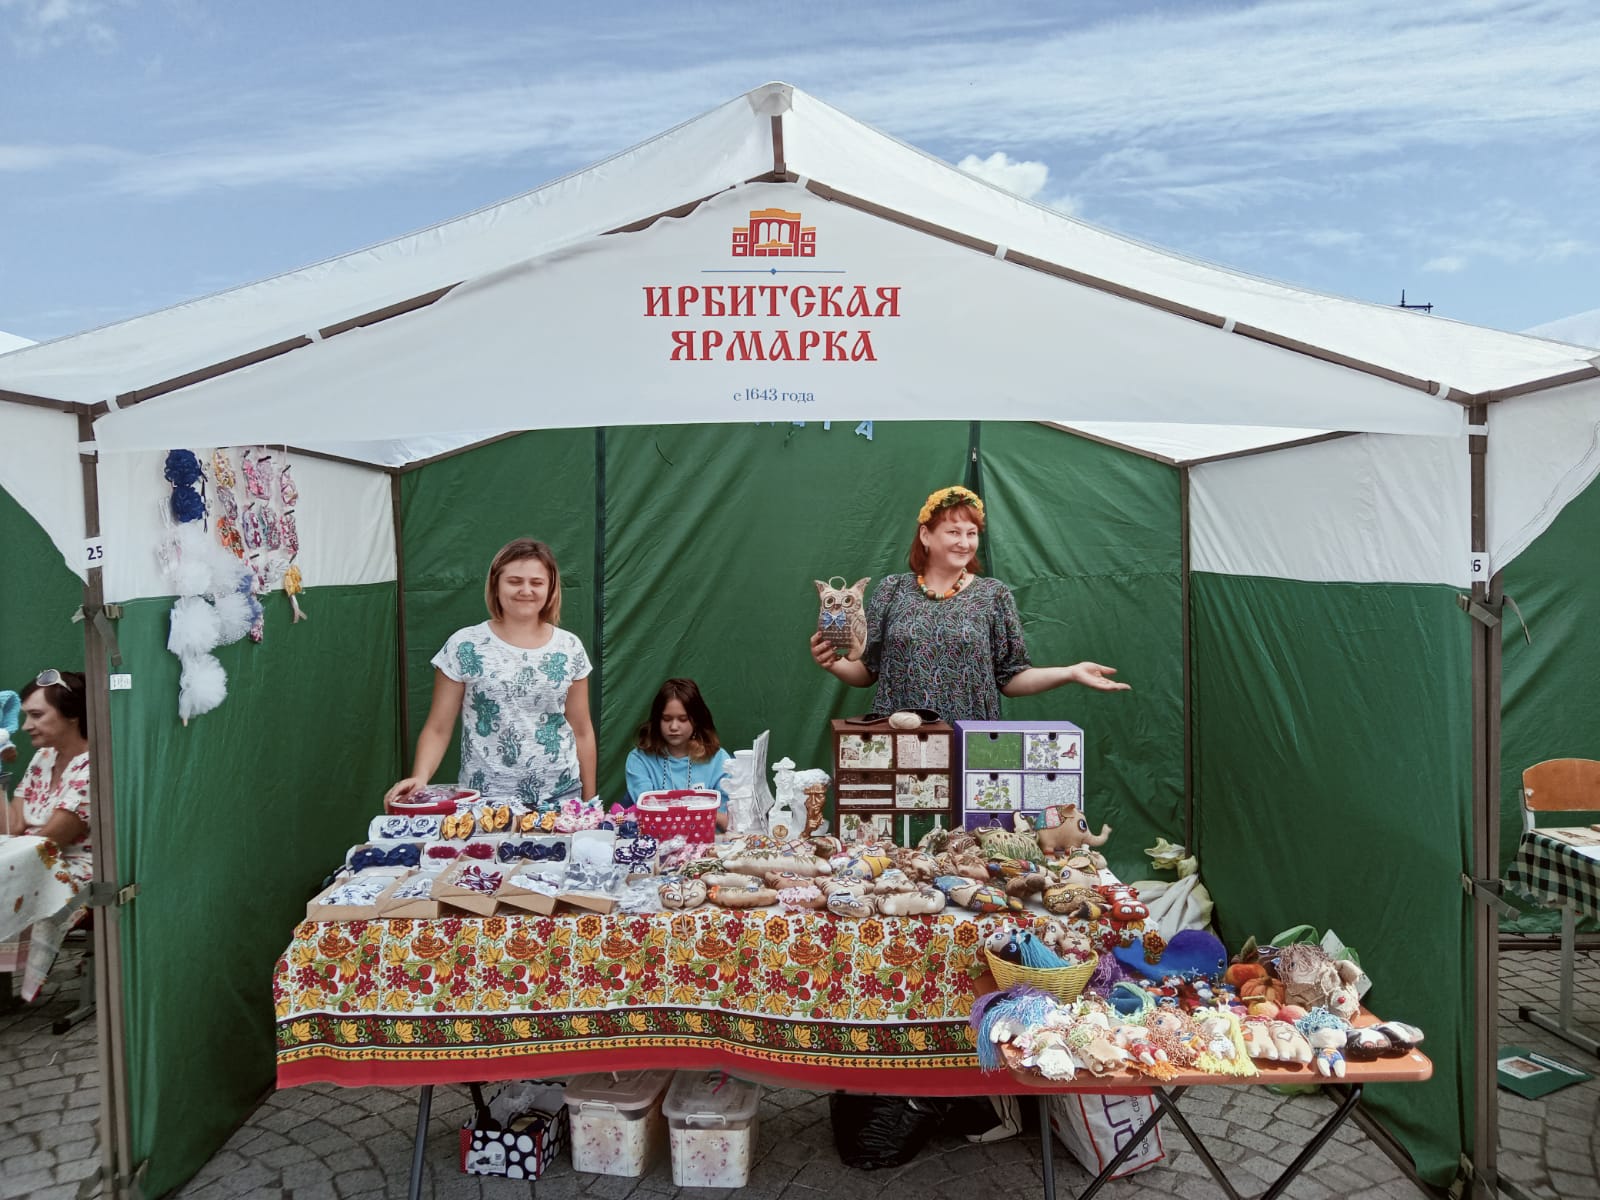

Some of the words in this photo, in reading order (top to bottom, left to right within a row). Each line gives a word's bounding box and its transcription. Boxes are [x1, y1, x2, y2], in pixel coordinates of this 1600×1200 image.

[642, 285, 902, 318] ИРБИТСКАЯ
[669, 330, 878, 362] ЯРМАРКА
[733, 392, 742, 402] с
[745, 388, 778, 401] 1643
[781, 392, 816, 404] года
[86, 545, 104, 561] 25
[1471, 559, 1482, 573] 6
